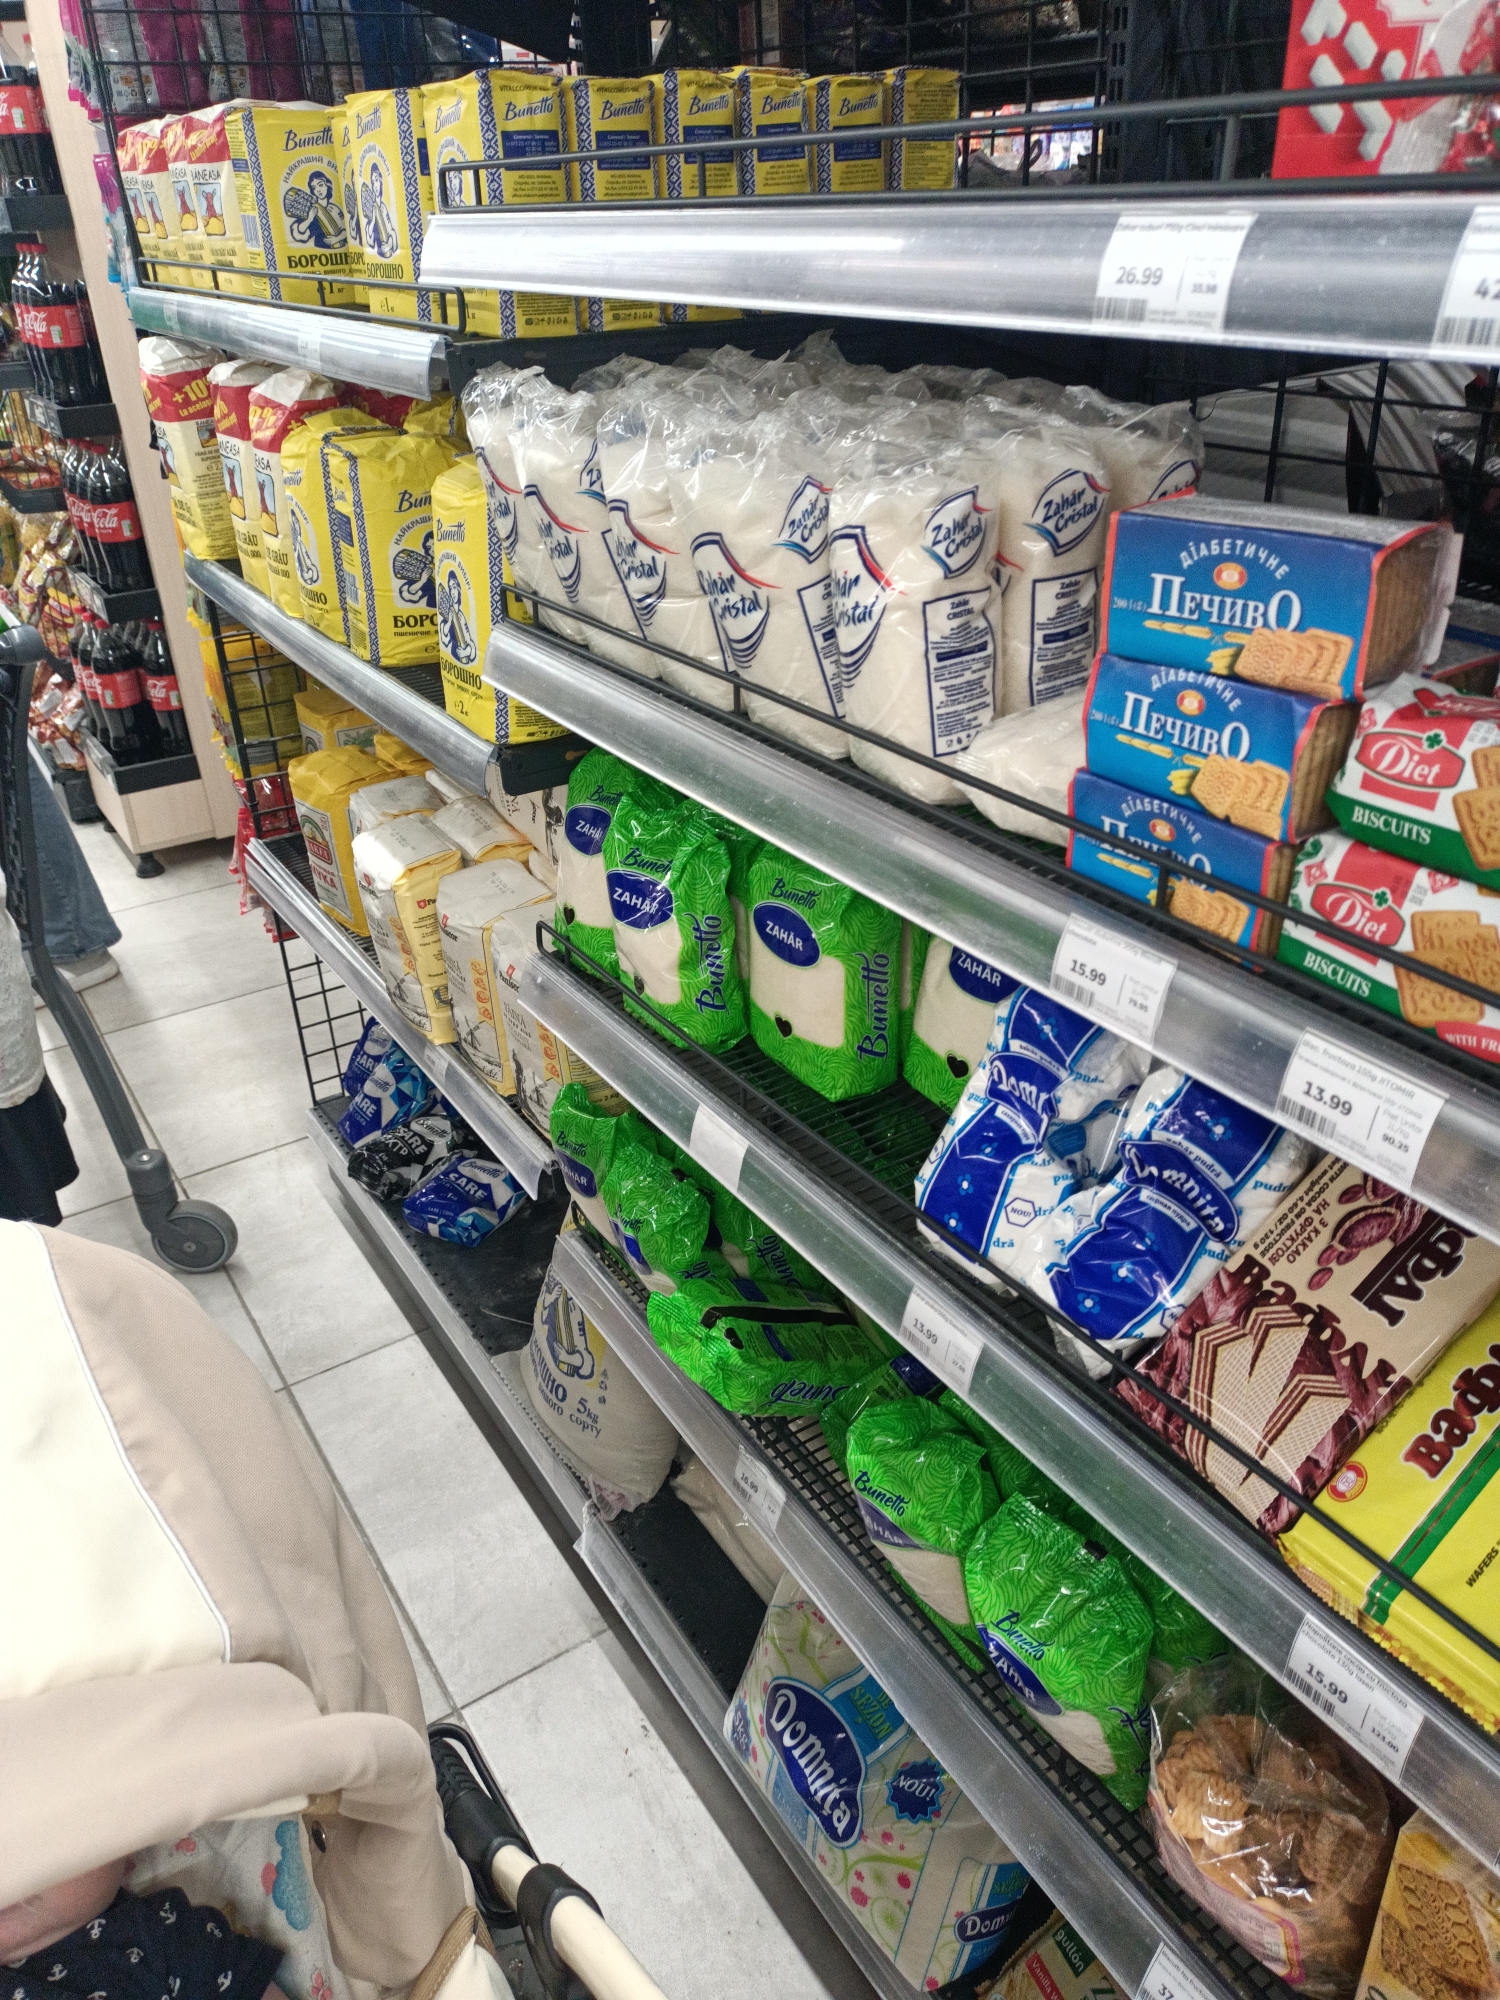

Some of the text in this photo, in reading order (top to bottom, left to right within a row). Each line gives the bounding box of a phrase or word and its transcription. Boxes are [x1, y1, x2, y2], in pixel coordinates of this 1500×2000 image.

[503, 96, 554, 121] Bunetto
[598, 98, 645, 121] Bunetto
[686, 93, 730, 115] Bunetto
[759, 90, 801, 115] Bunetto
[836, 92, 878, 117] Bunetto
[355, 105, 383, 139] Bunetto
[366, 262, 405, 279] БОРОШНО
[1115, 265, 1164, 287] 26.99
[172, 376, 213, 404] +10
[254, 453, 272, 473] EASA
[1054, 496, 1098, 533] Cristal
[436, 518, 466, 544] Bunetto
[944, 516, 983, 559] Cristal
[715, 589, 763, 622] Cristal
[946, 607, 975, 621] CRISTAL
[1147, 572, 1302, 633] ПЕЧИВО
[440, 656, 483, 691] БОРОШНО
[1118, 691, 1251, 762] ПЕЧИВО
[1370, 736, 1441, 785] Diet
[1352, 804, 1432, 845] BISCUITS
[612, 886, 659, 915] ZAHĂR
[768, 877, 823, 910] Bunetto
[1325, 890, 1387, 942] Diet
[765, 920, 804, 952] ZAHĂR
[684, 912, 731, 1016] Bunetto
[957, 952, 1002, 987] ZAHĂR
[1070, 959, 1107, 987] 15.99
[1303, 950, 1372, 998] BISCUITS
[854, 952, 891, 1063] Bunetto
[1445, 1033, 1478, 1048] WITH
[1302, 1080, 1353, 1117] 13.99
[399, 1124, 427, 1155] SARE
[556, 1130, 588, 1158] Bunetto
[1381, 1132, 1410, 1154] 90.25
[459, 1160, 502, 1180] Bunetto
[1192, 1153, 1223, 1180] pudră
[448, 1172, 488, 1201] SARE
[1303, 1168, 1330, 1196] weight
[1306, 1183, 1330, 1208] COCOA
[1010, 1207, 1032, 1219] NOU!
[1296, 1202, 1314, 1220] ON
[993, 1237, 1014, 1249] dră
[1259, 1216, 1298, 1259] FRUCTOSE
[1260, 1227, 1276, 1247] 130
[1267, 1198, 1332, 1268] НА ФРУКТОЗІ
[1285, 1226, 1322, 1265] КАКАО
[912, 1318, 938, 1345] 13.99
[569, 1412, 602, 1439] сорту
[576, 1396, 600, 1425] 5kg
[1401, 1343, 1500, 1479] Ваф
[853, 1469, 911, 1518] Bunetto
[1465, 1544, 1500, 1588] WAFERS
[990, 1609, 1056, 1662] Bunetto
[1305, 1662, 1349, 1704] 15.99
[1054, 1928, 1086, 1973] gullón
[1031, 1959, 1053, 1994] Vanilla
